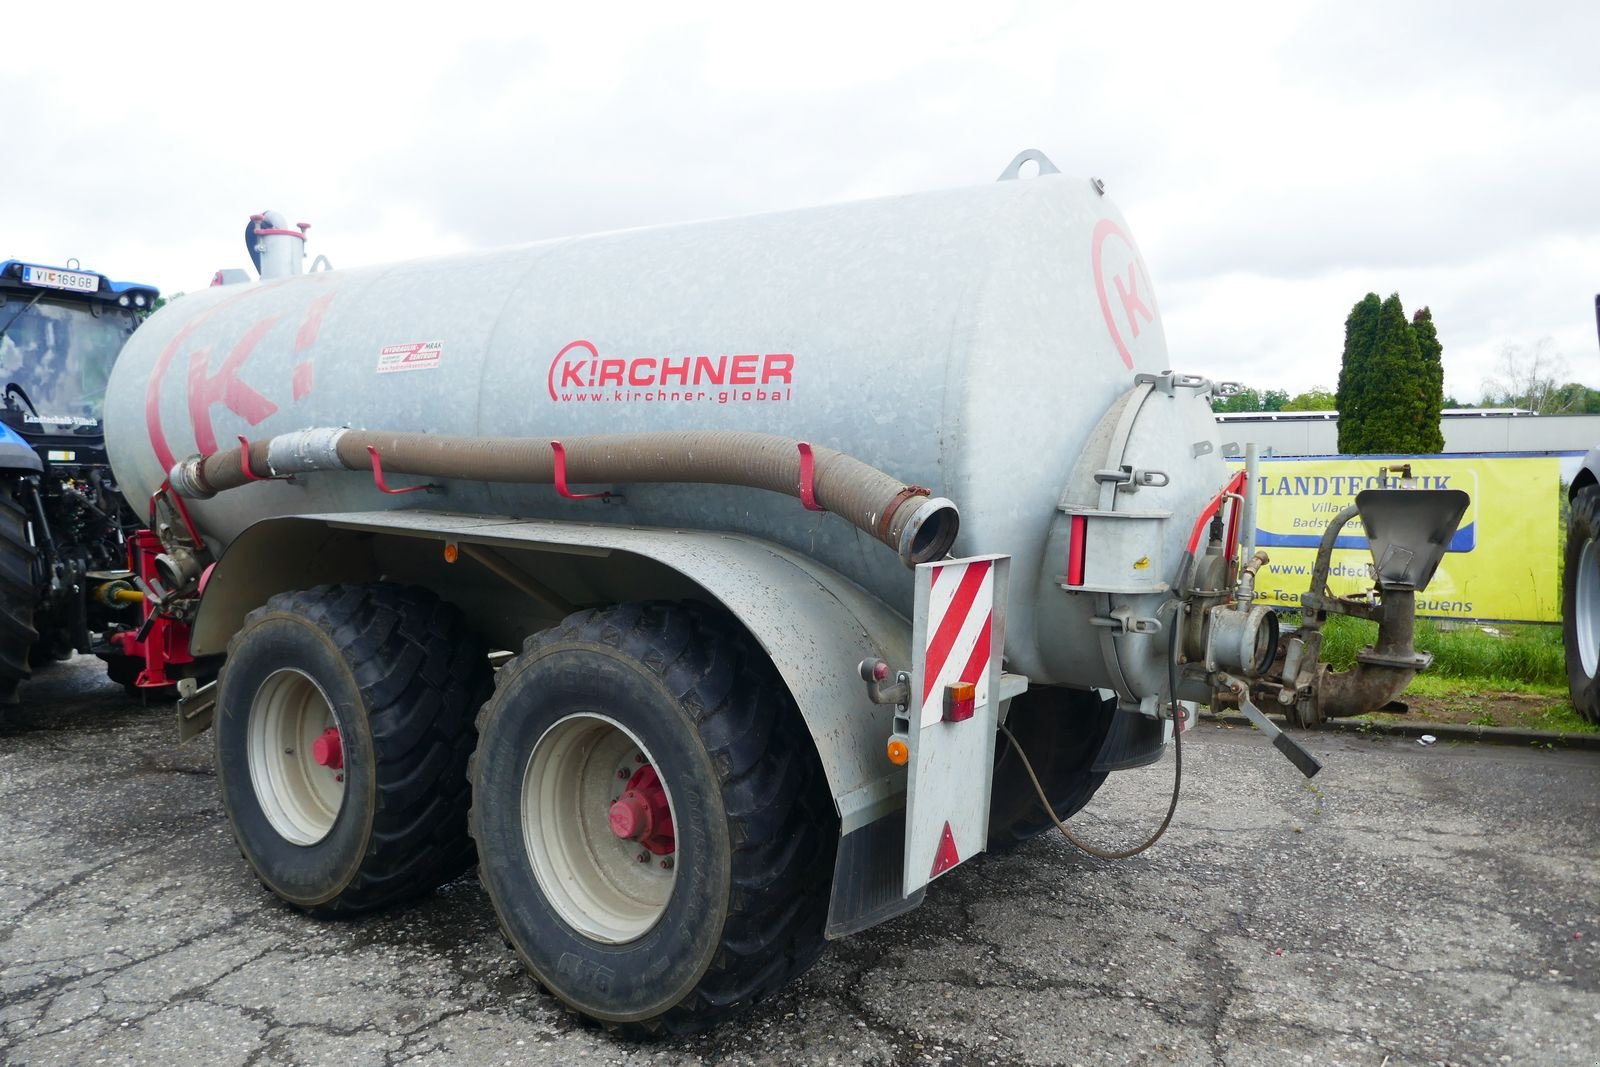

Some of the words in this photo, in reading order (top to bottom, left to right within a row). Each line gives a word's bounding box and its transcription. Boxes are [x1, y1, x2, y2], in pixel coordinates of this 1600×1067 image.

[58, 275, 76, 286] 169
[78, 277, 93, 289] GB
[561, 389, 792, 404] www.kirchner.global
[1273, 589, 1300, 602] Tea
